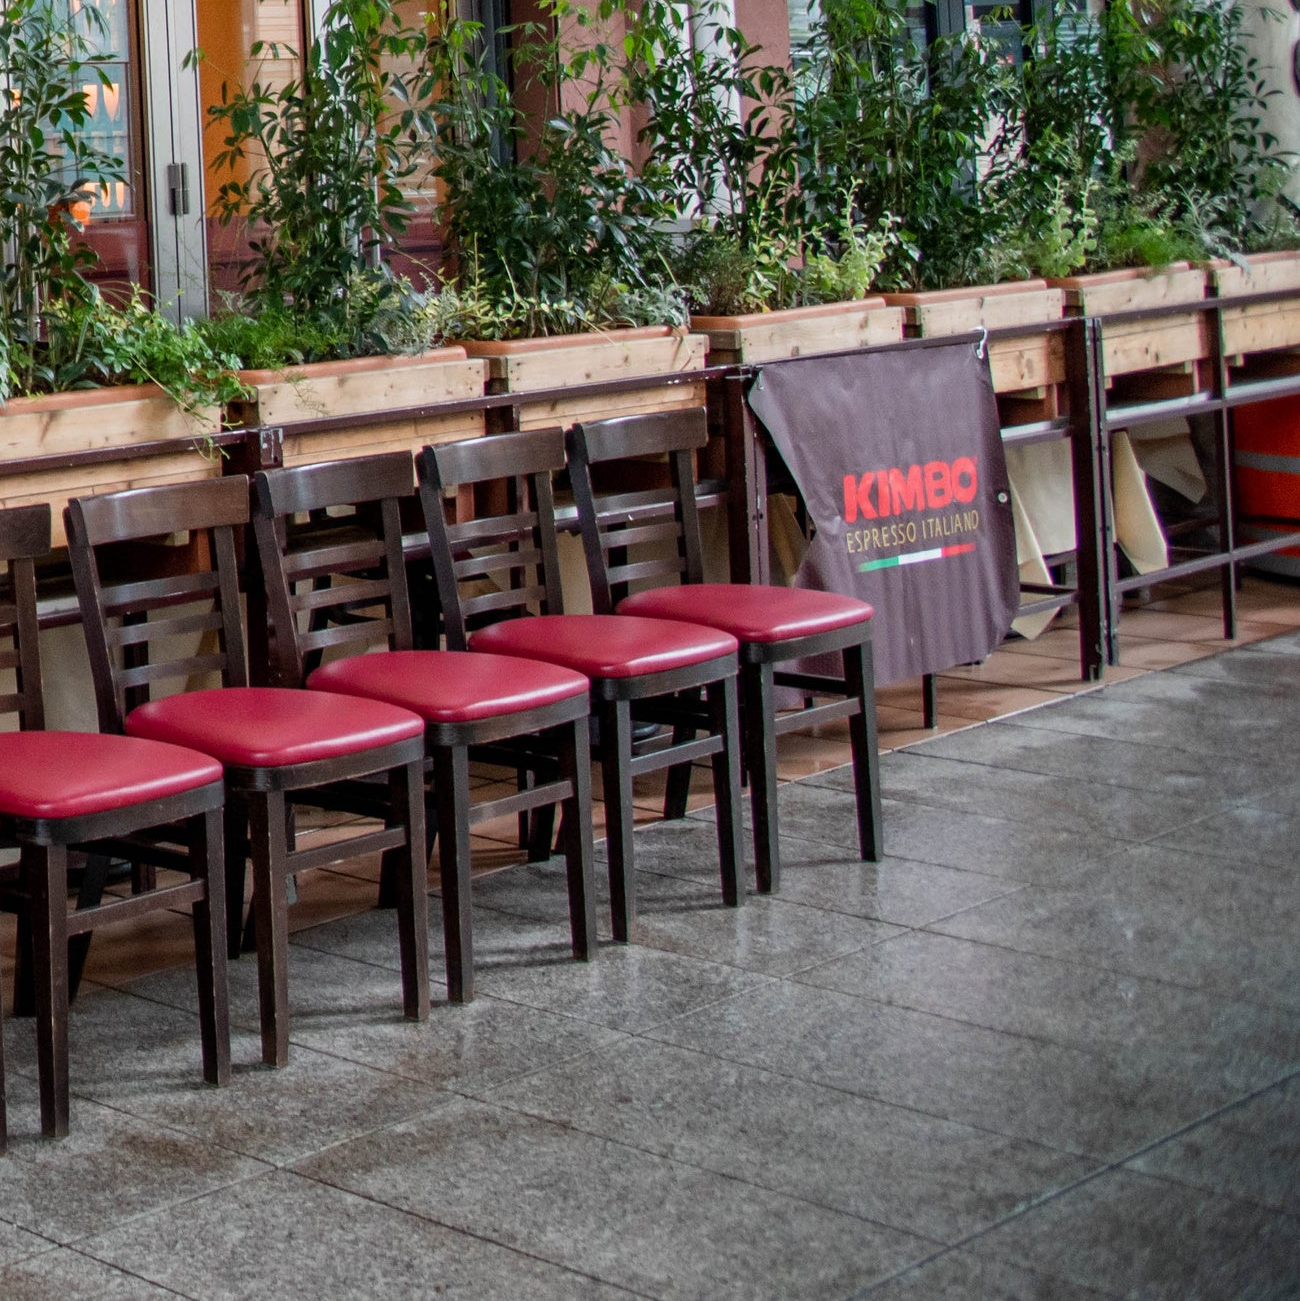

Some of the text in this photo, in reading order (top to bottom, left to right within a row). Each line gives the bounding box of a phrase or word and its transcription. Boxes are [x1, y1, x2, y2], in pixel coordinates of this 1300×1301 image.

[843, 456, 977, 523] KIMBO
[847, 510, 979, 553] ESPRESSO ITALIANO
